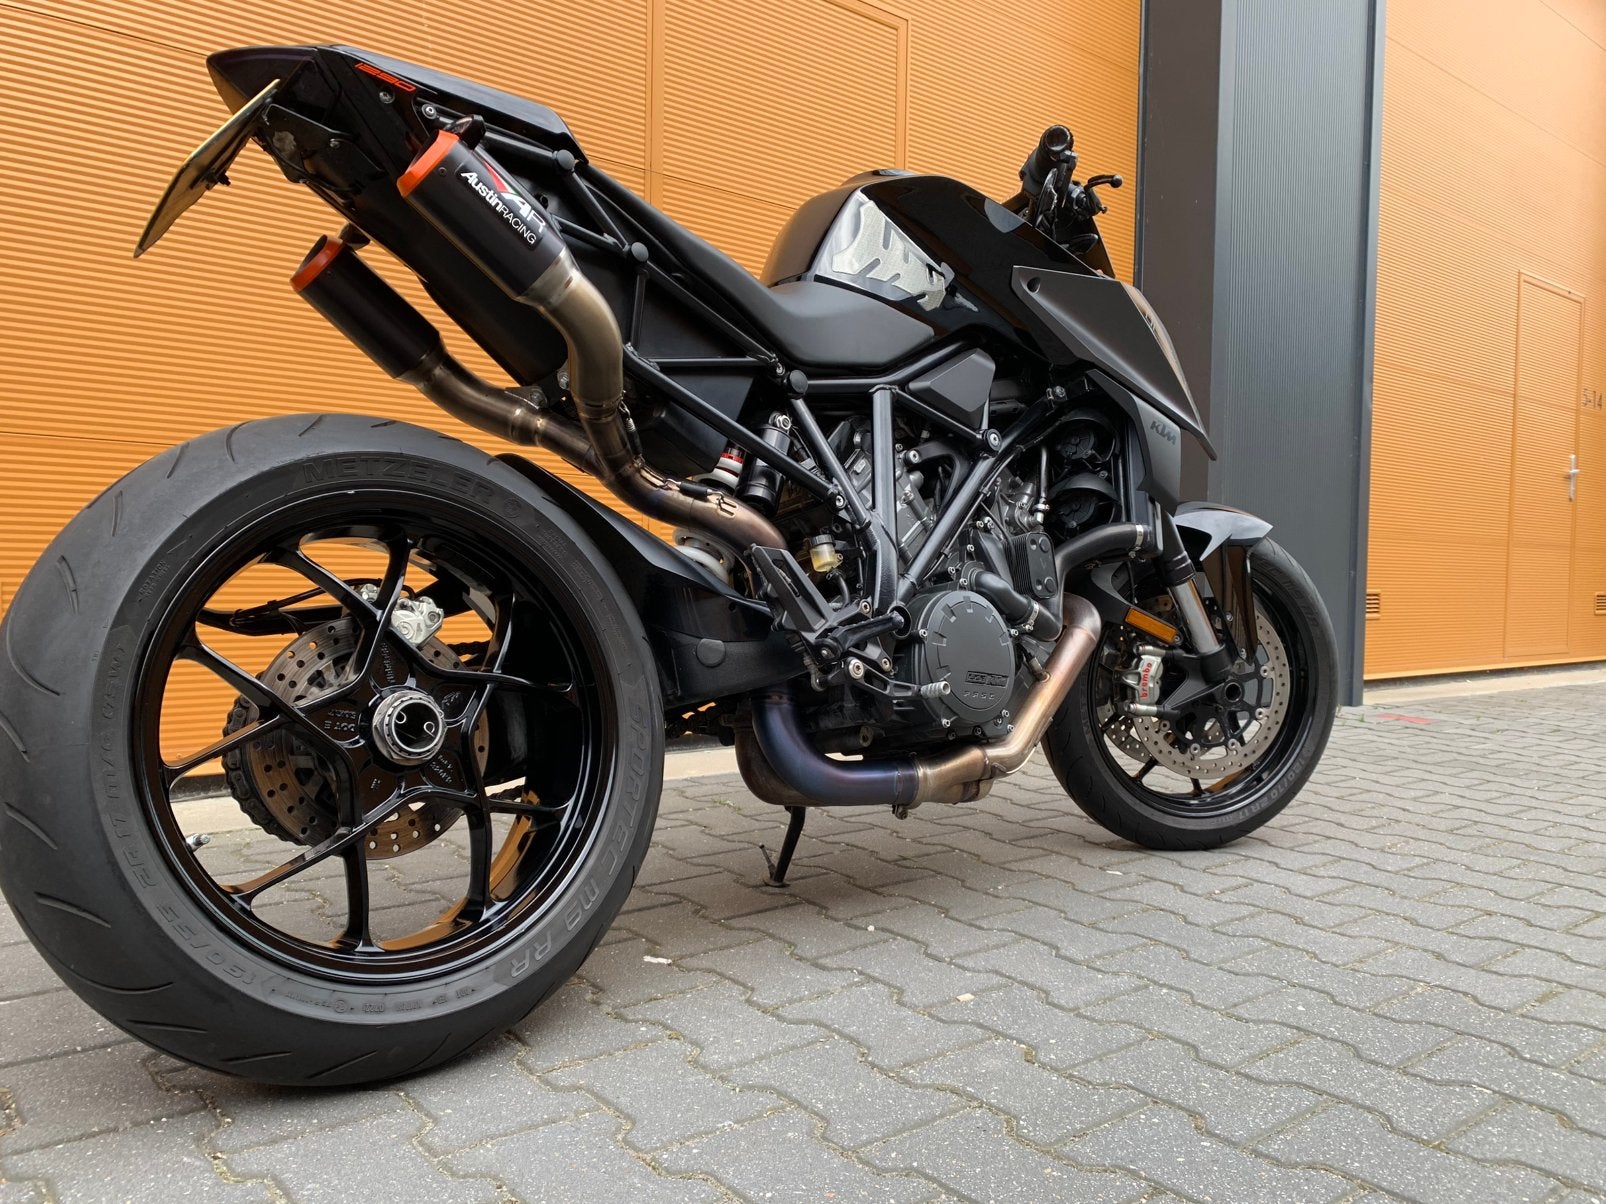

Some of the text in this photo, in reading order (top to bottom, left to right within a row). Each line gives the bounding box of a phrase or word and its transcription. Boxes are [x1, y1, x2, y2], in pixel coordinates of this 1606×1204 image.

[1150, 420, 1177, 445] KTM
[301, 454, 497, 504] METZELER
[1140, 662, 1153, 699] brembo
[599, 706, 647, 876] SPORTEC
[509, 932, 560, 978] RR
